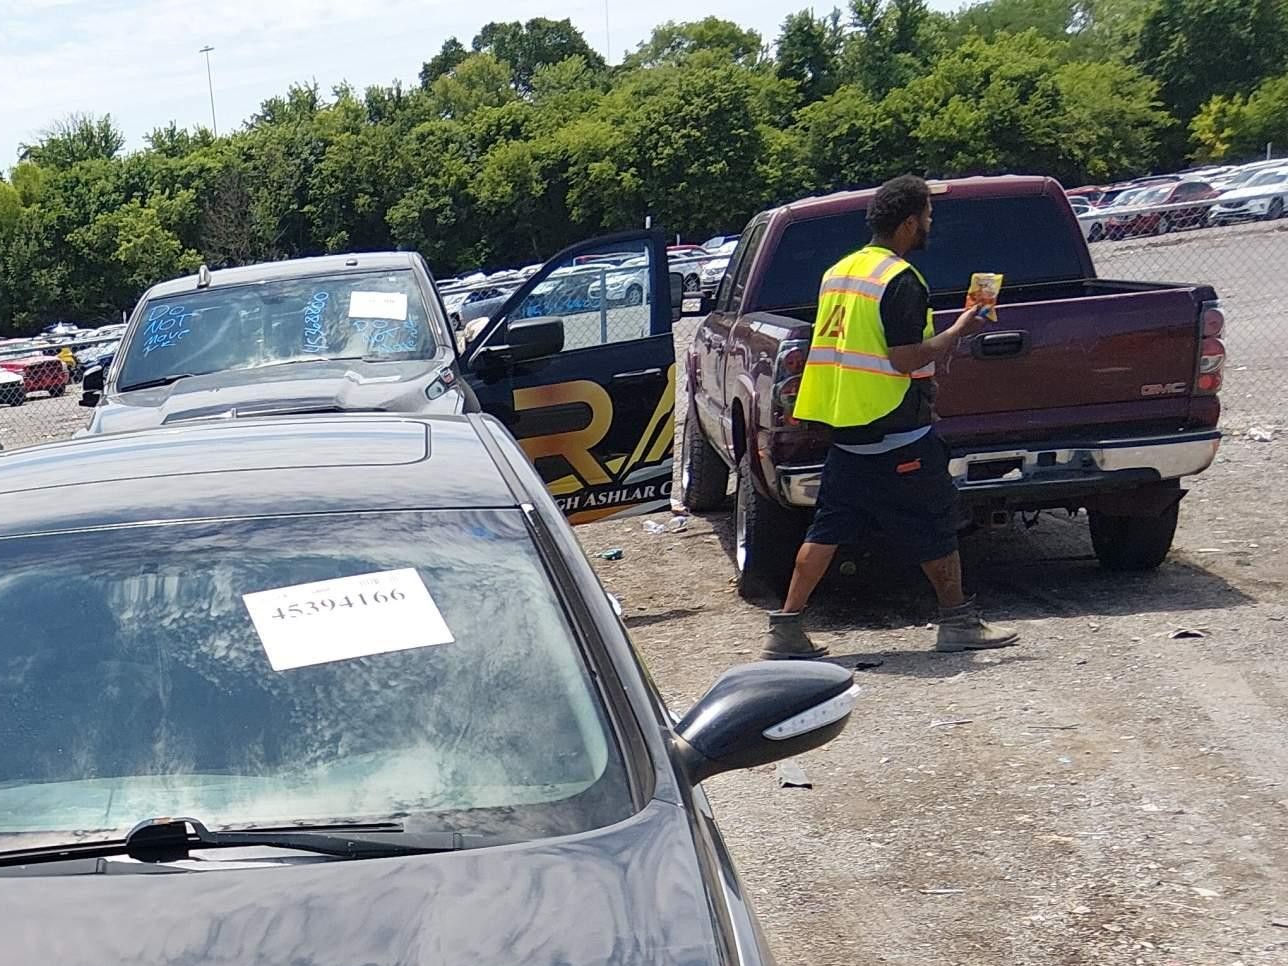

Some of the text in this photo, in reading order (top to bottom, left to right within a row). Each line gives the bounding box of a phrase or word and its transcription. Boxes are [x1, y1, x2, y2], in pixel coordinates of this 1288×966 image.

[148, 304, 185, 321] DO
[143, 312, 201, 336] NOT
[1141, 382, 1186, 396] GMC
[583, 485, 656, 507] ASHLAR
[271, 587, 406, 620] 45394166
